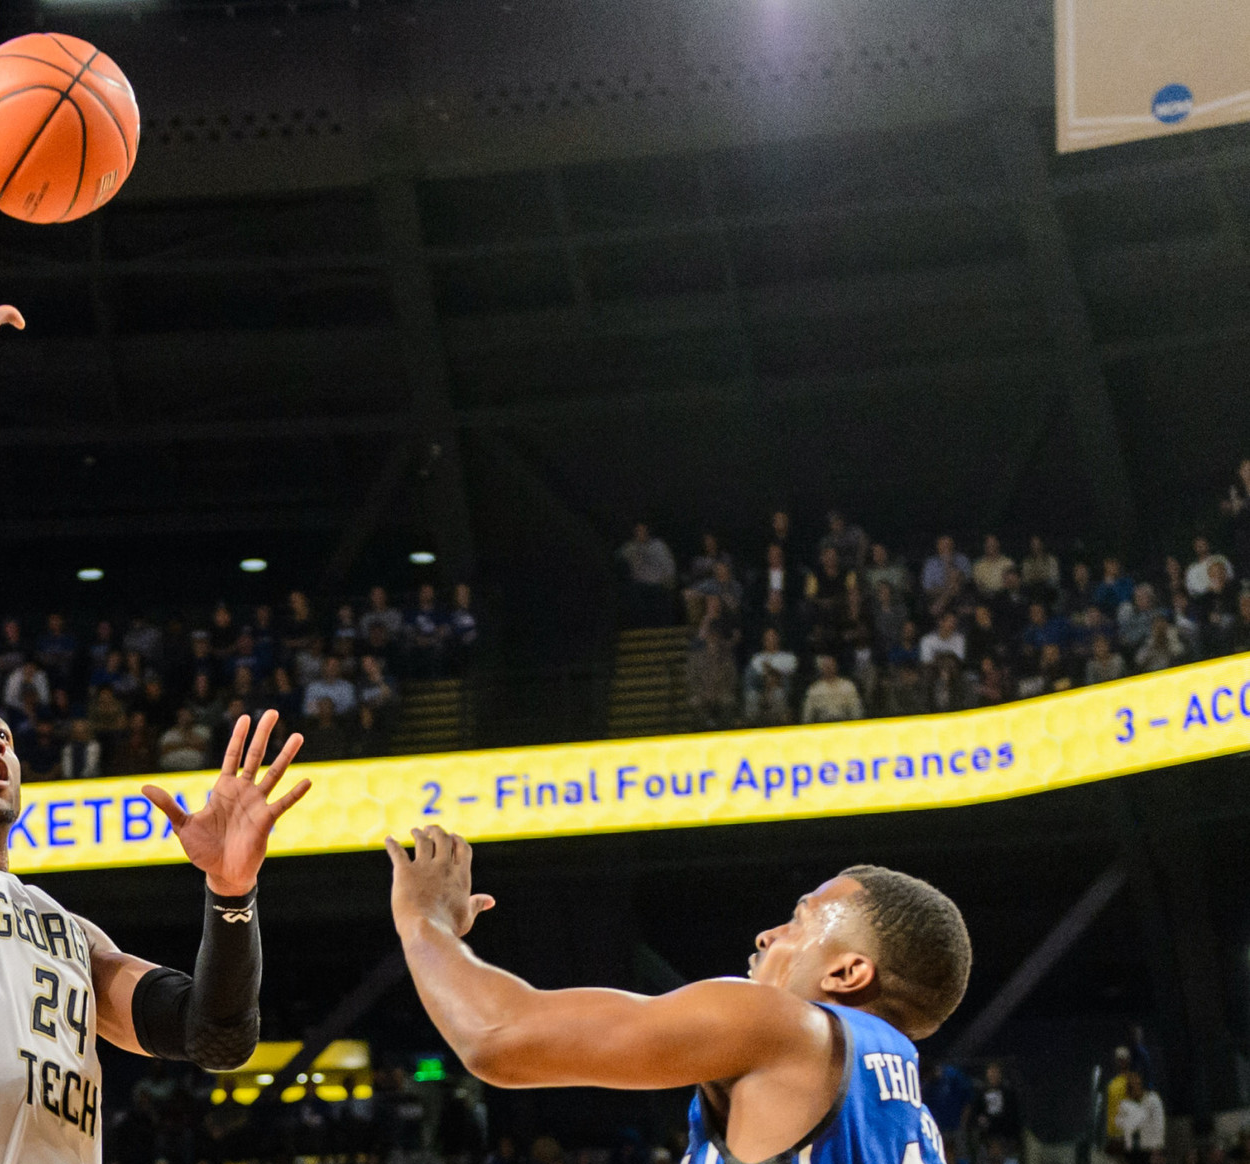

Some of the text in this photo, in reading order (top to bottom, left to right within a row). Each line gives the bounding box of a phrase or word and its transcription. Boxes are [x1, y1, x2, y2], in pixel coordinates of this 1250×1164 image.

[1116, 706, 1136, 744] 3
[421, 781, 442, 816] 2
[496, 769, 599, 809] Final
[616, 765, 716, 801] Four
[731, 742, 1015, 799] Appearances
[31, 964, 90, 1058] 24
[17, 1047, 101, 1140] TECH
